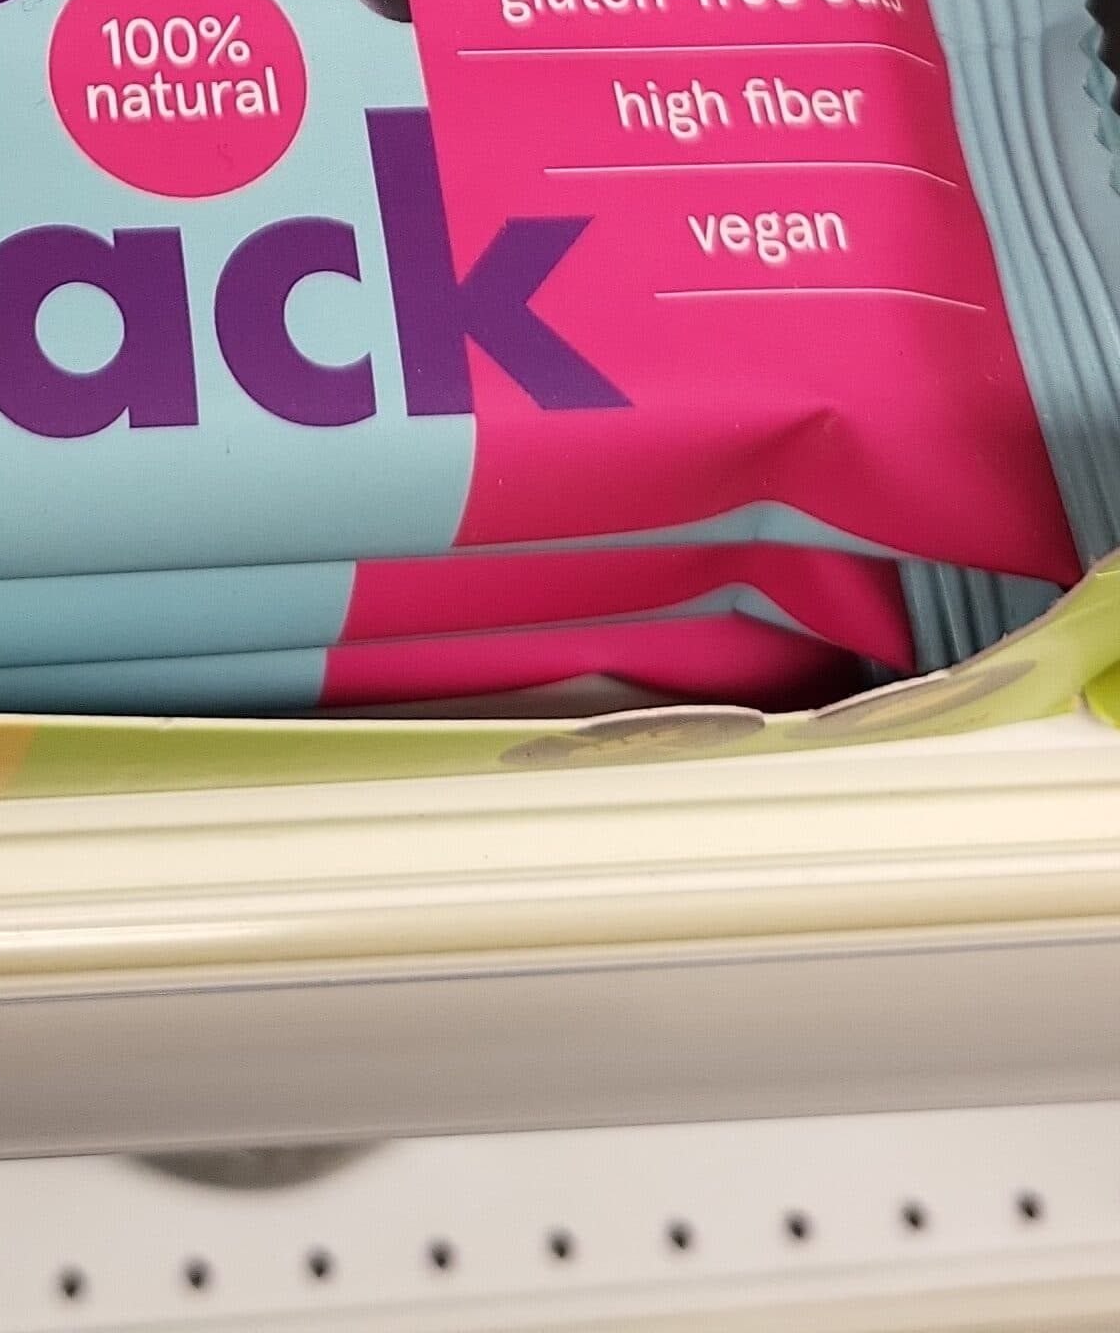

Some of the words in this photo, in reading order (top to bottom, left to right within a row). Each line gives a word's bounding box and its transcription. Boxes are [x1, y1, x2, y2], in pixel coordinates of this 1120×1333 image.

[100, 13, 251, 71] 100%
[85, 66, 280, 124] natural
[613, 79, 730, 139] high
[742, 77, 864, 132] fiber
[687, 204, 848, 263] vegan
